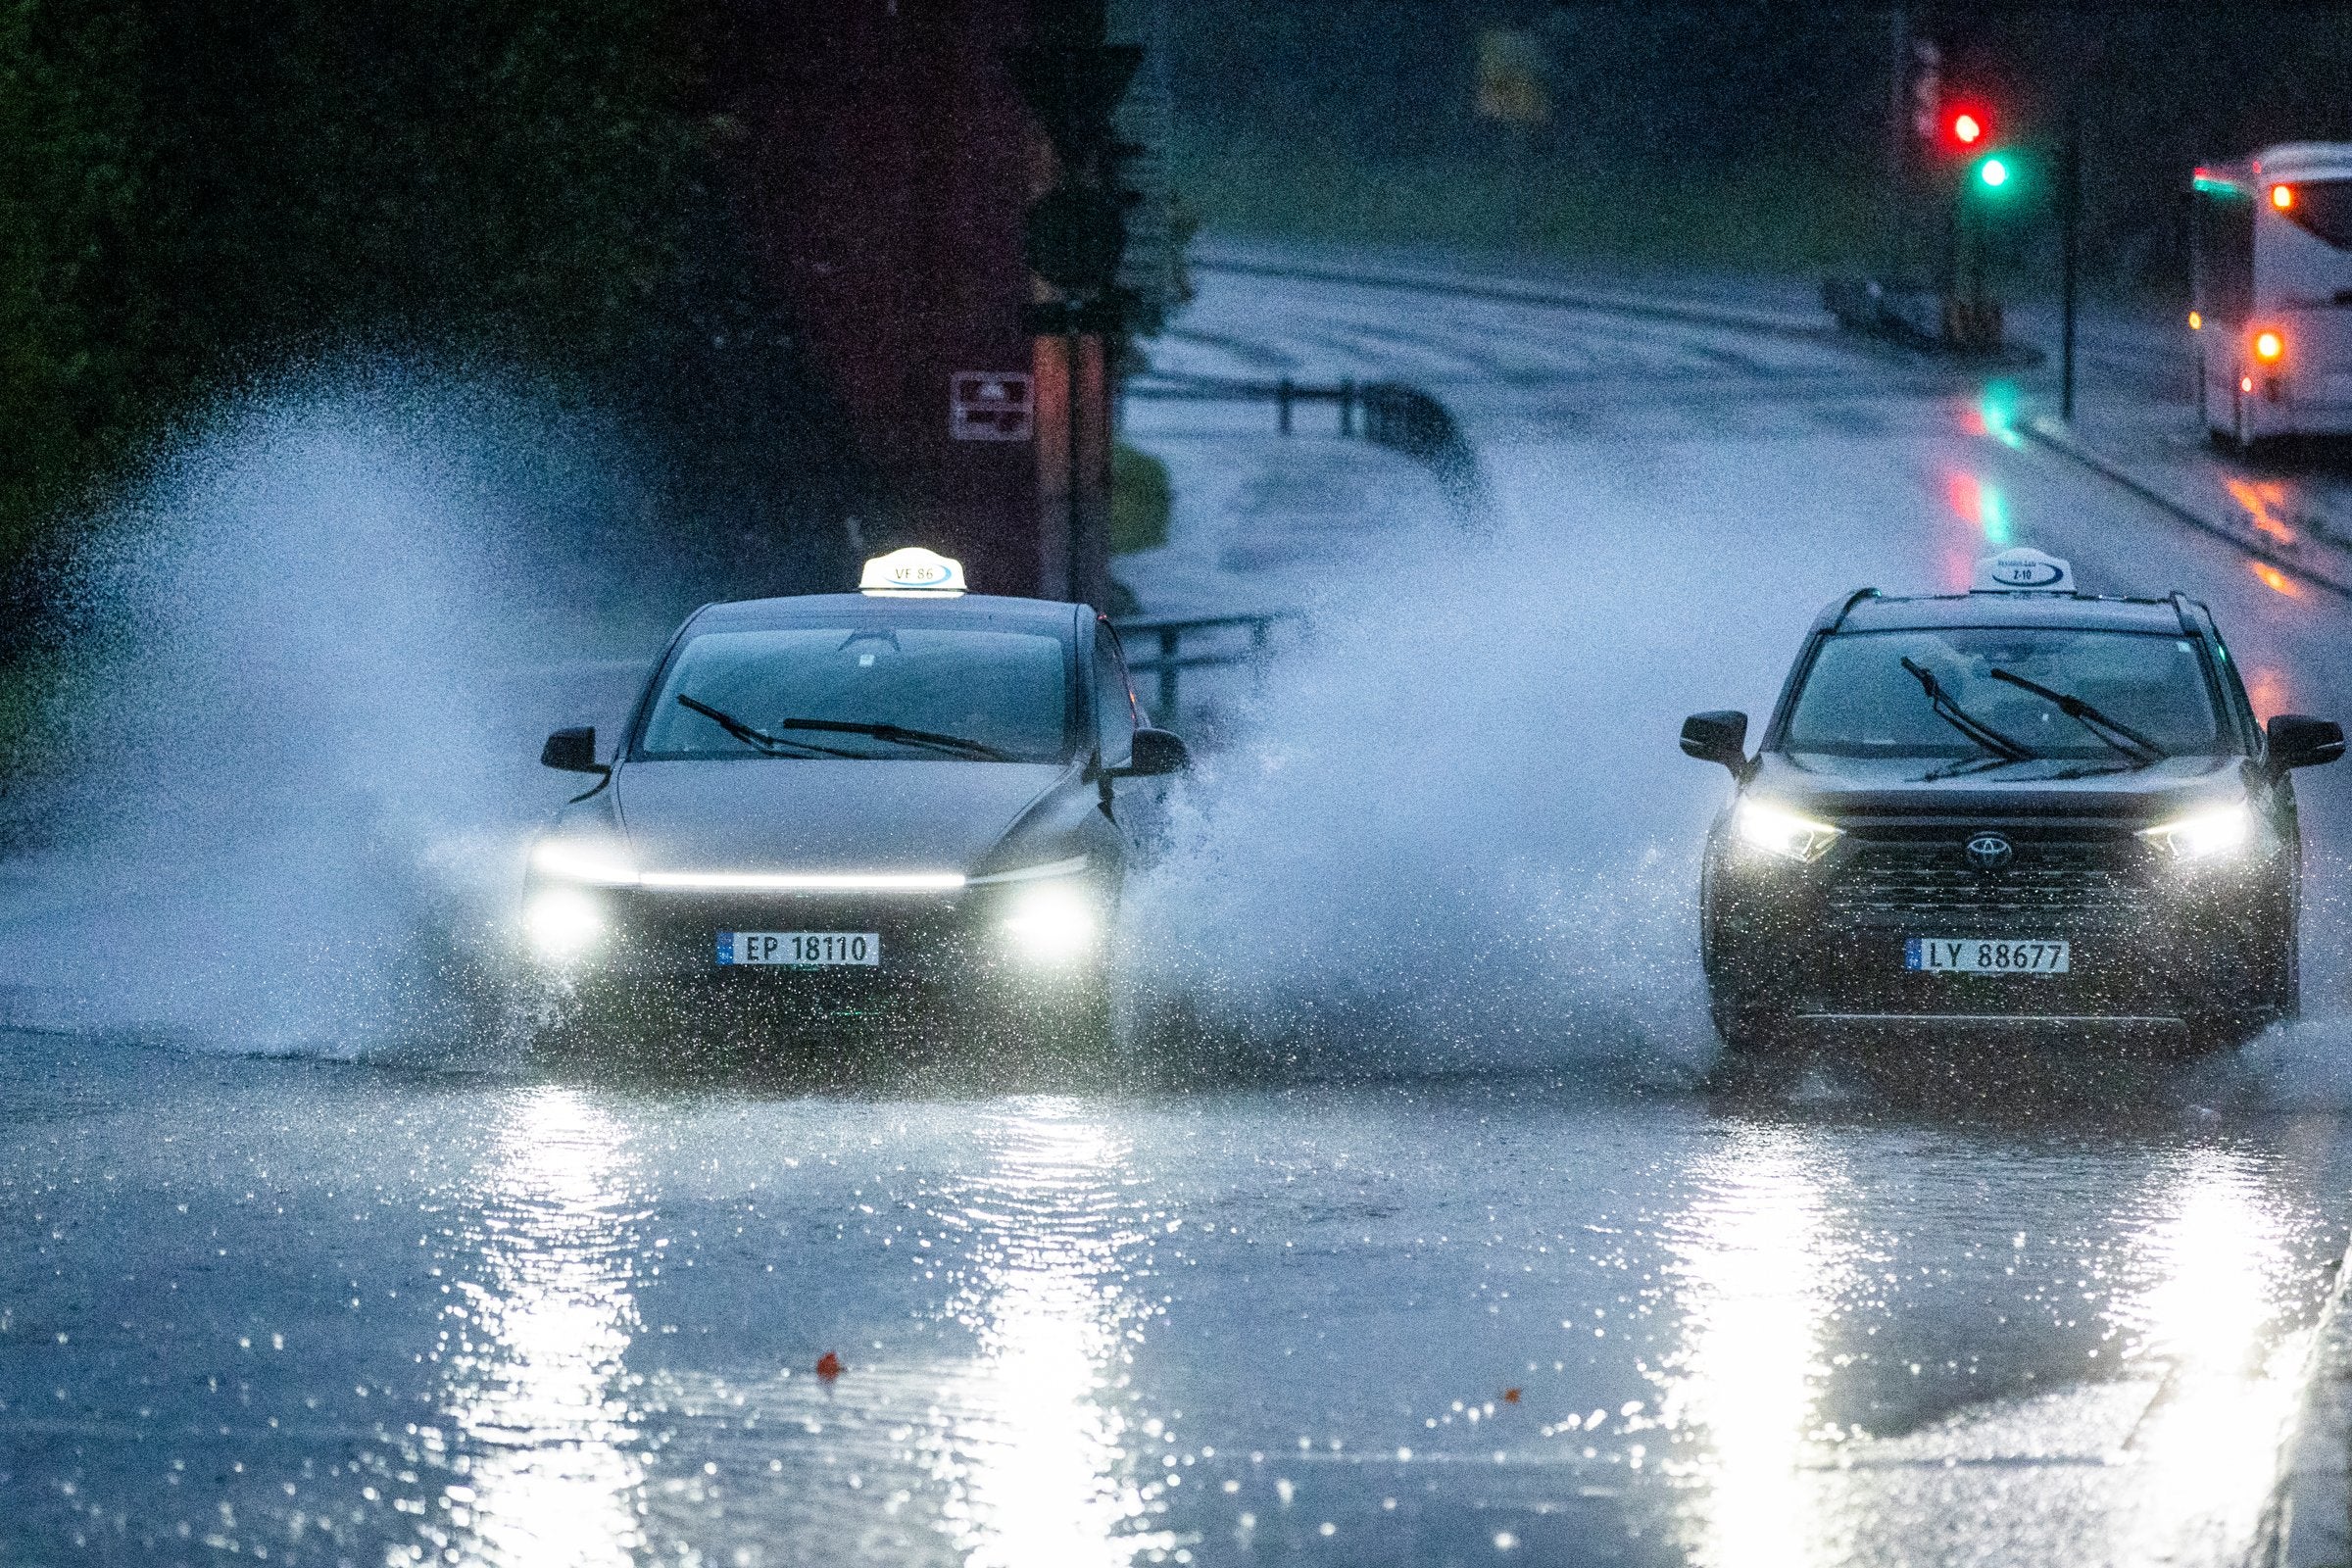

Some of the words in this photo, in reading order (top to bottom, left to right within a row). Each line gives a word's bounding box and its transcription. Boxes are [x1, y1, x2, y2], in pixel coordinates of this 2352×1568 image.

[917, 567, 934, 580] 86
[747, 936, 778, 960] EP
[792, 936, 866, 961] 18110
[1930, 942, 1962, 967] LY
[1978, 943, 2062, 969] 88677
